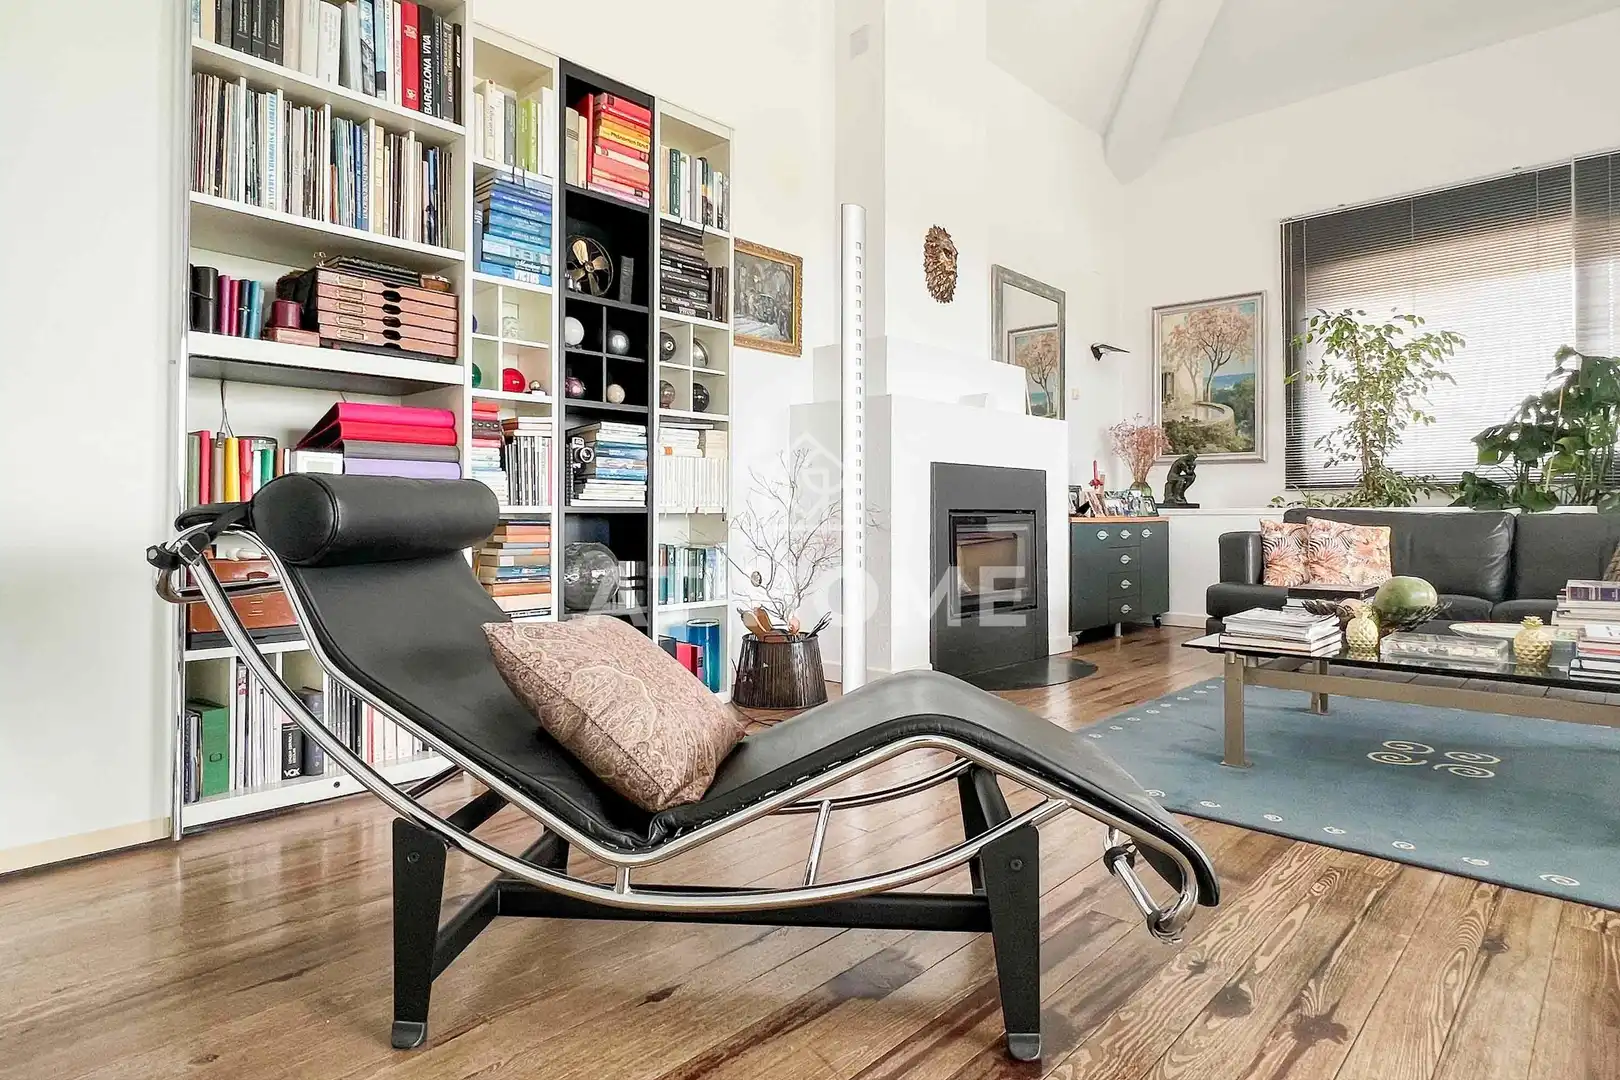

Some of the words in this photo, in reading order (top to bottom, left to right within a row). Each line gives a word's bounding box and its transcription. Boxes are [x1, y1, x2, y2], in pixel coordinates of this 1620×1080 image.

[422, 35, 432, 54] VIVA
[423, 58, 433, 115] BARCELONA
[283, 767, 301, 777] VOX
